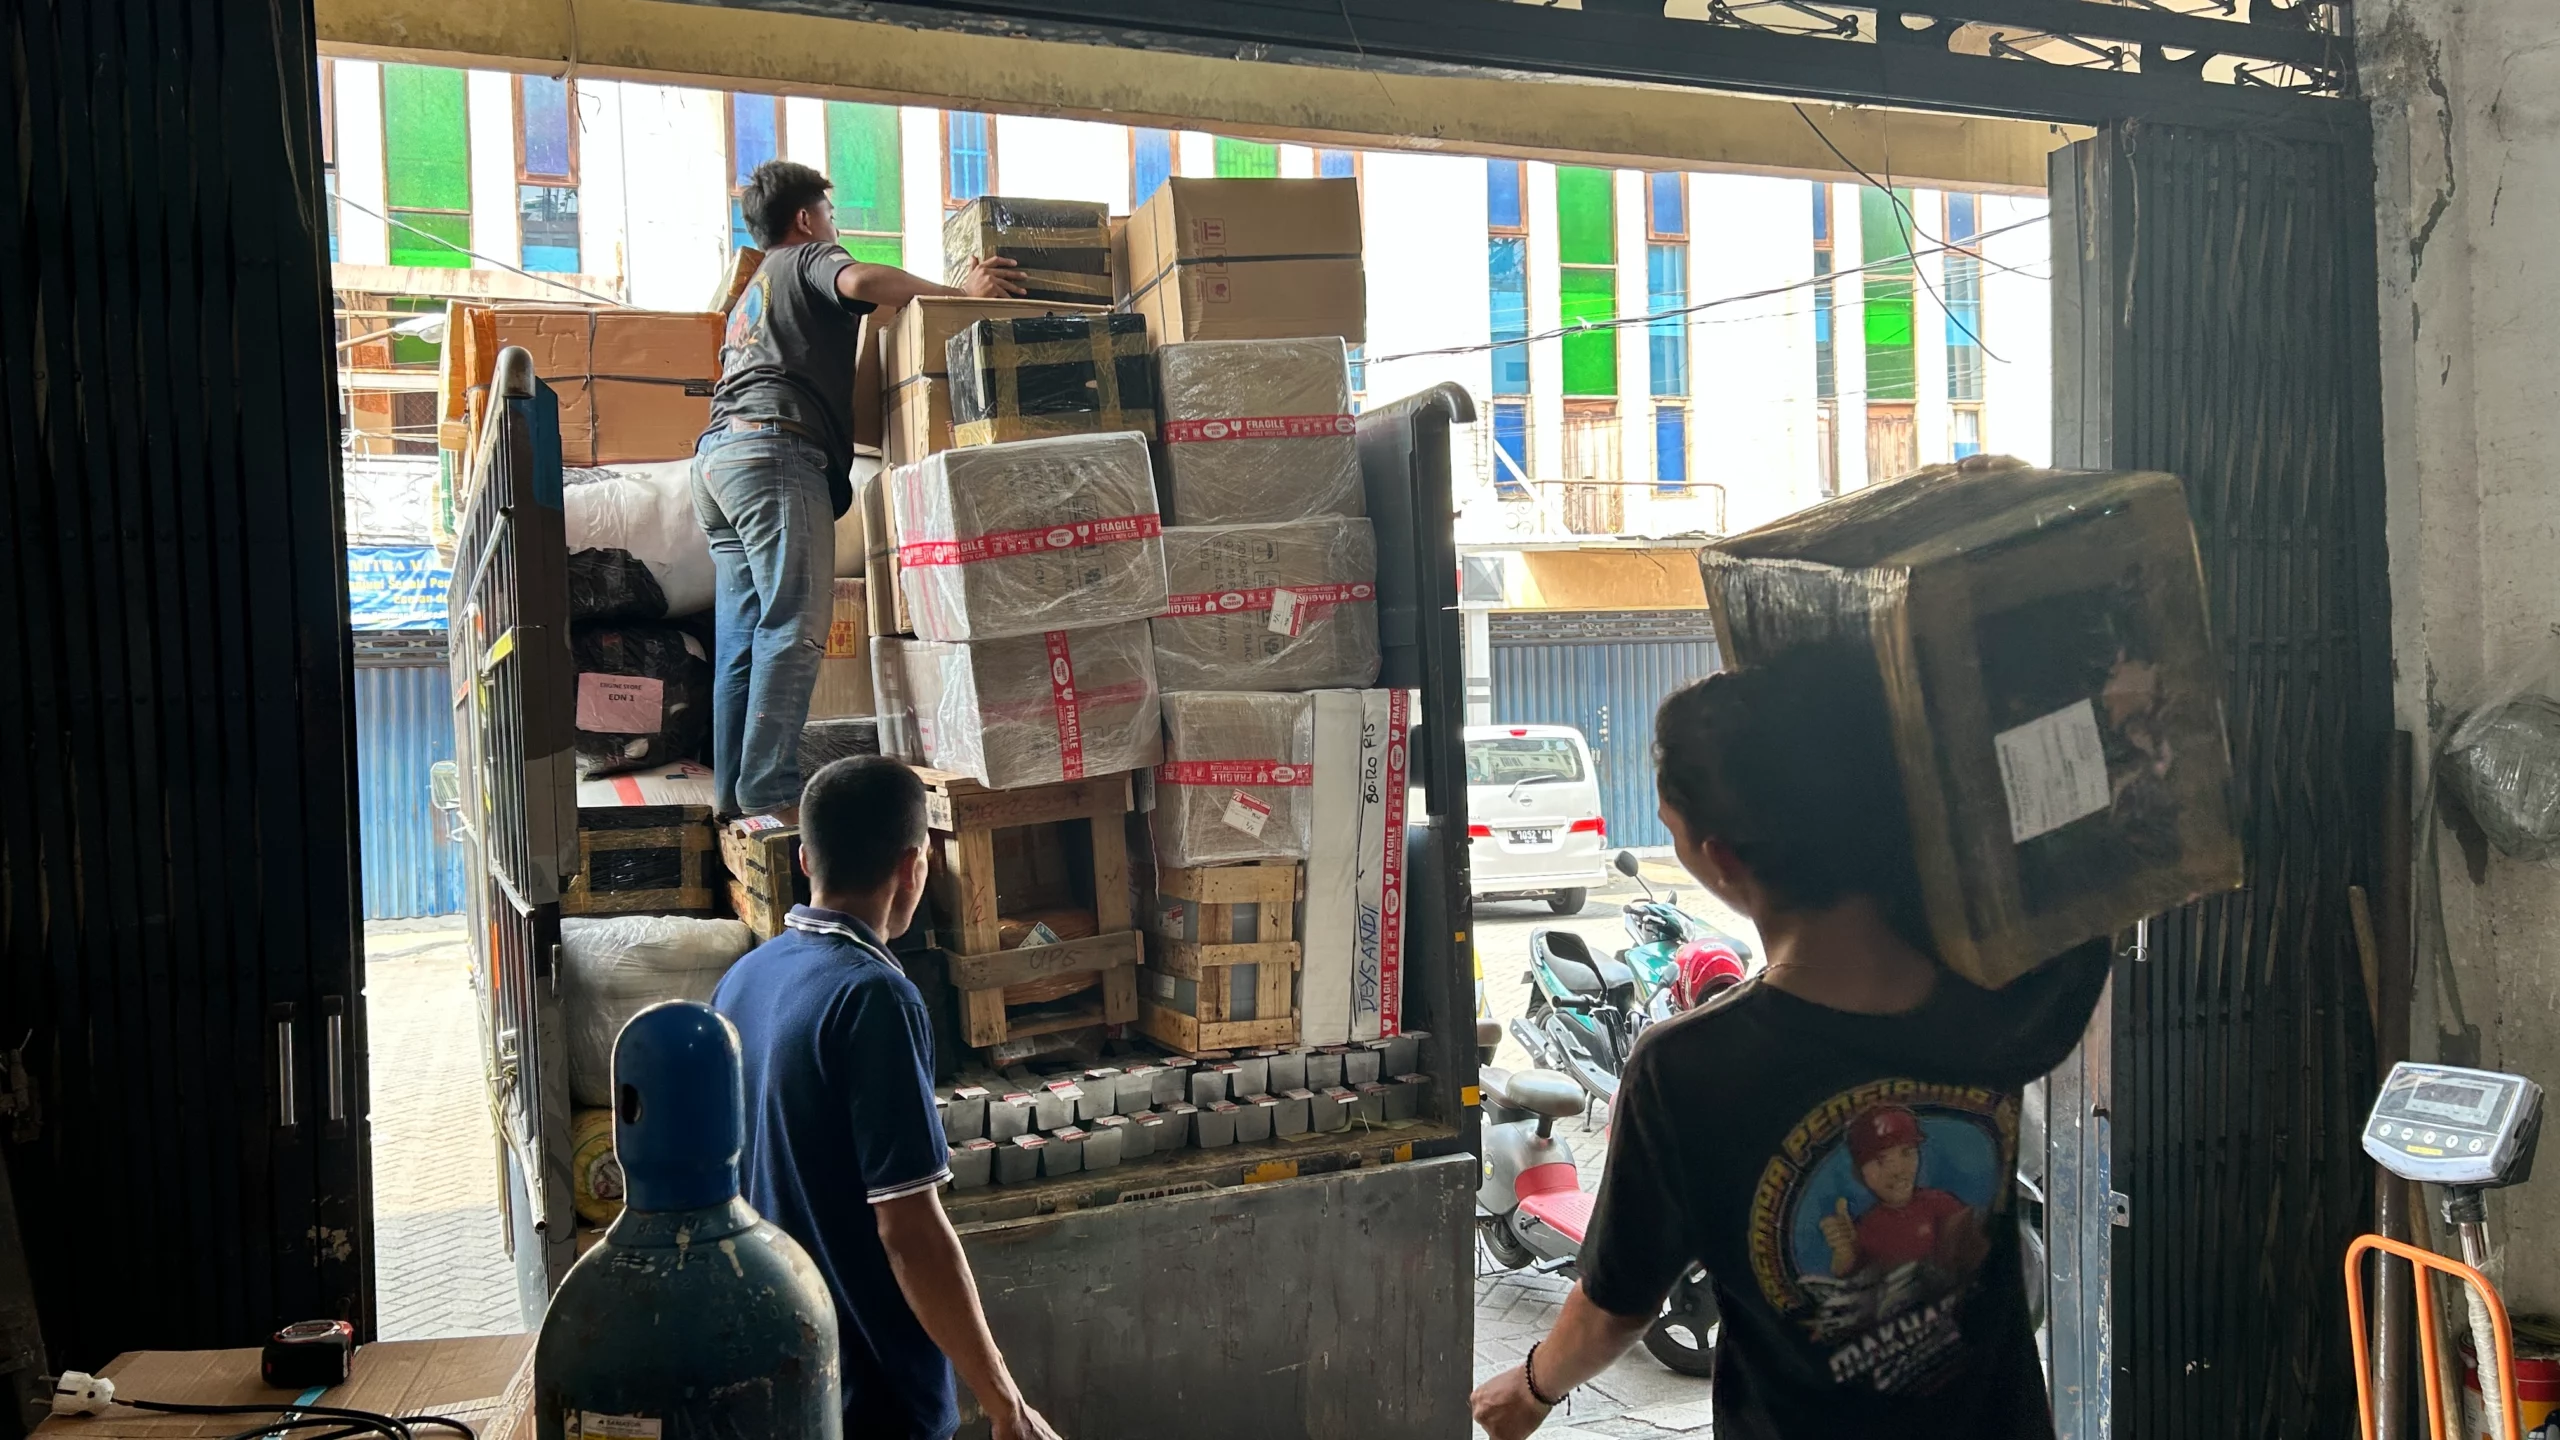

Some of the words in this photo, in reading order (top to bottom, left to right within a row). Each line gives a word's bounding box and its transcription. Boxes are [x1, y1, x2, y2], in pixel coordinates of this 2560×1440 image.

[1246, 419, 1285, 429] FRAGILE
[1094, 520, 1137, 533] FRAGILE
[608, 693, 627, 702] EDN
[630, 694, 635, 702] 1
[1392, 689, 1400, 725] FRAGIL
[1066, 704, 1078, 749] FRAGILE
[1211, 773, 1252, 782] FRAGILE
[1386, 826, 1395, 869] FRAGILE
[1383, 971, 1391, 1014] FRAGILE
